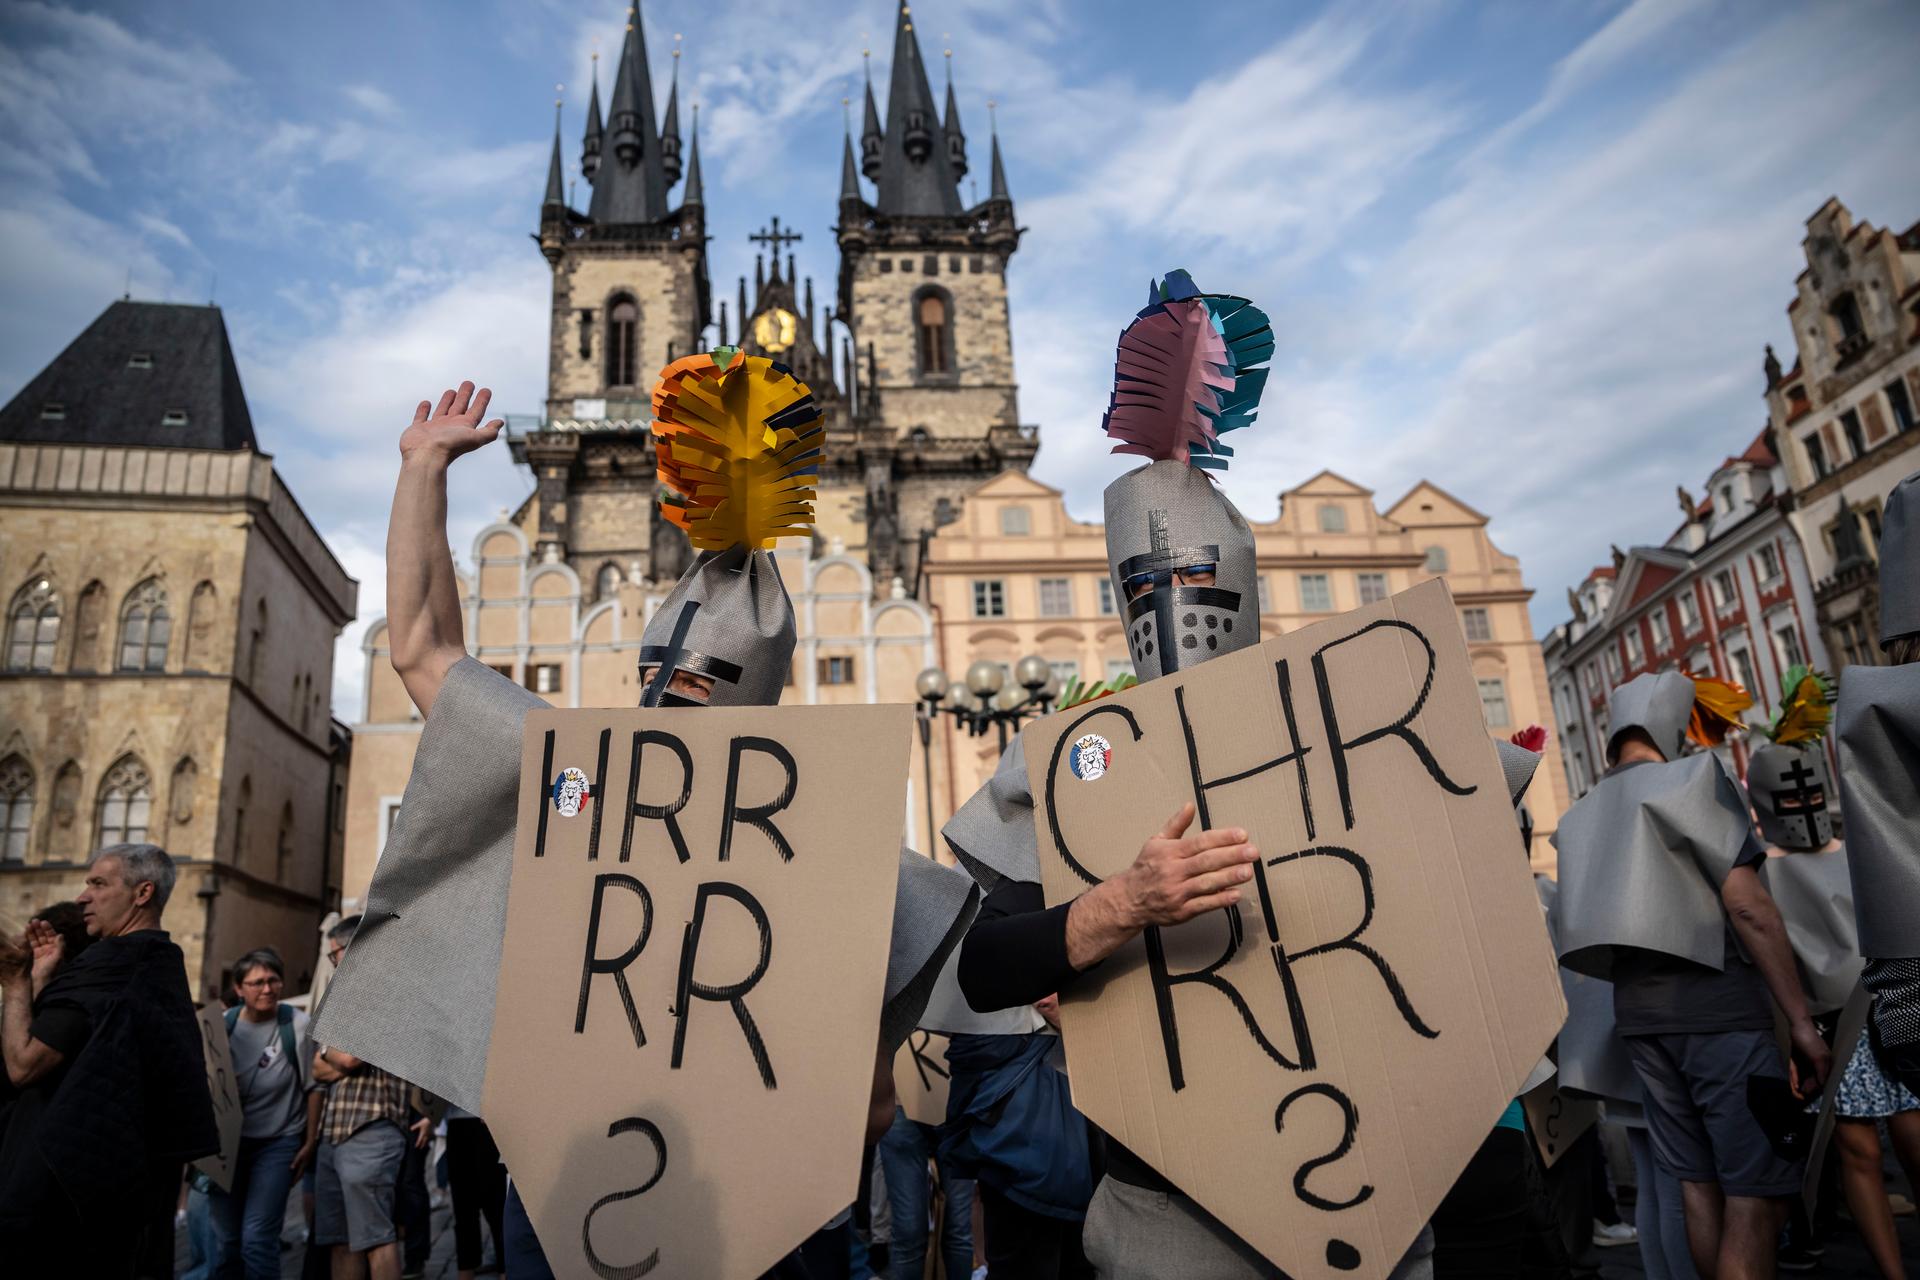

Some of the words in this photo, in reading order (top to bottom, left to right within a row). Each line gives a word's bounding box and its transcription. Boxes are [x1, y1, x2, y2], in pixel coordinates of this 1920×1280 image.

[534, 727, 799, 864] HRR
[1045, 619, 1478, 885] CHR
[574, 873, 777, 1091] RR
[908, 1029, 951, 1093] R
[1143, 846, 1440, 1094] RR
[1275, 1083, 1374, 1271] ?
[1545, 1095, 1563, 1156] ?
